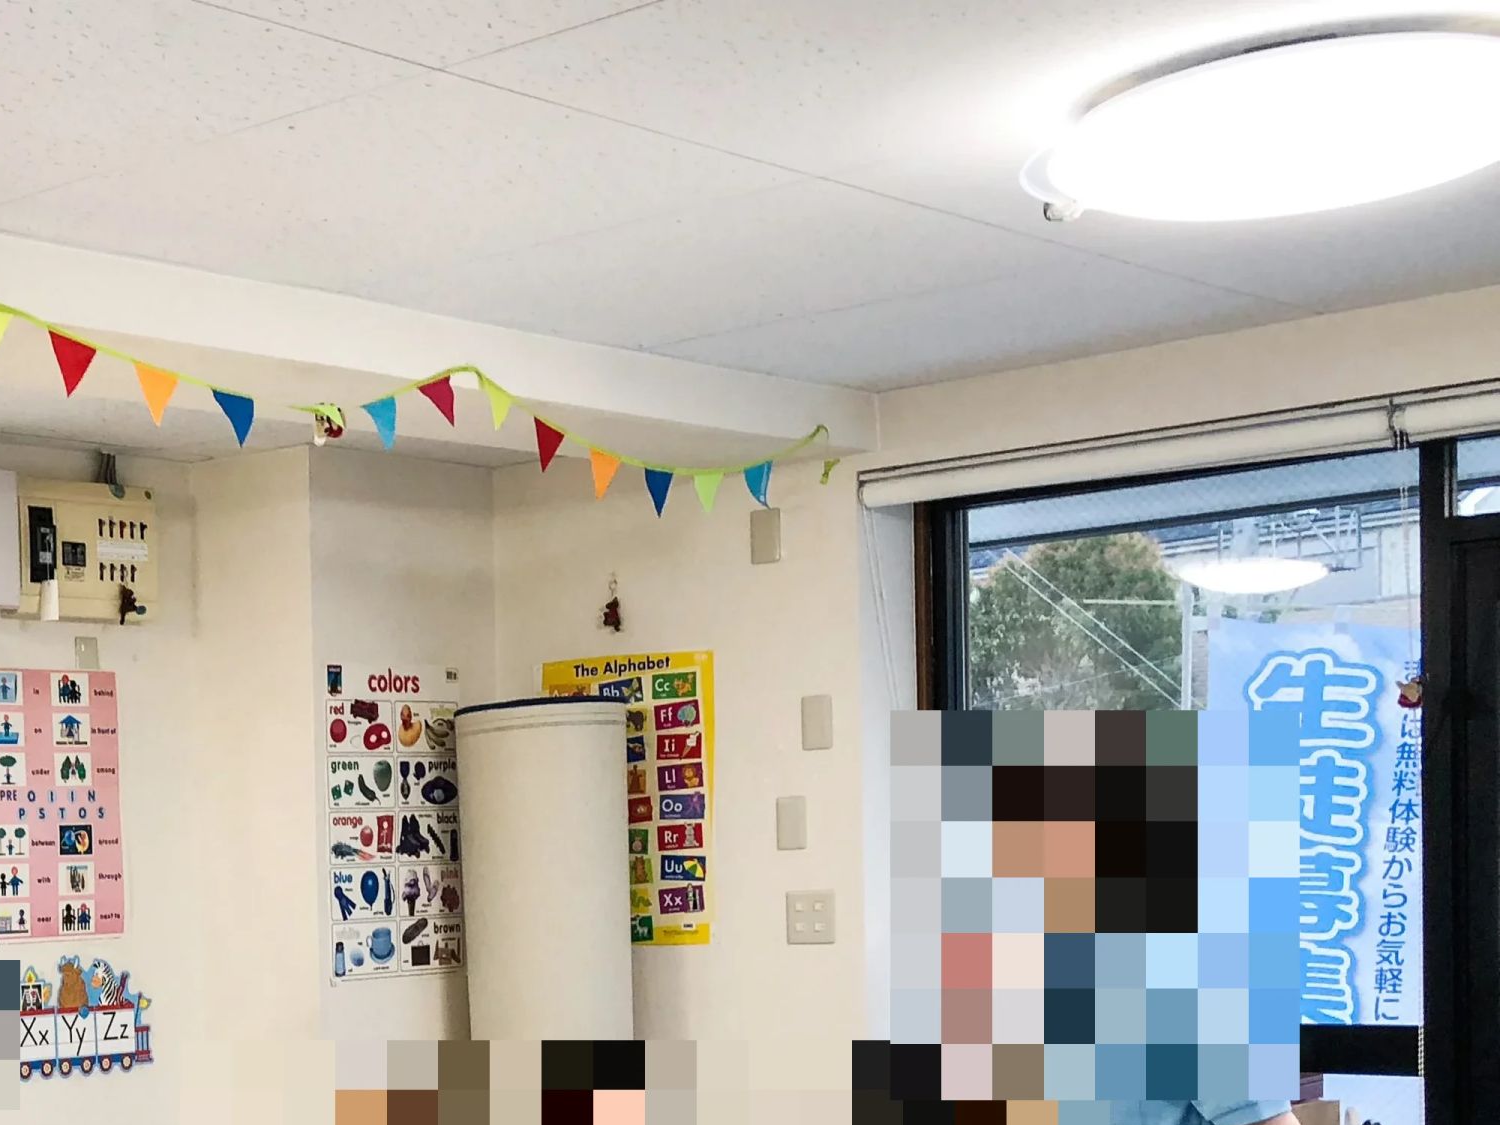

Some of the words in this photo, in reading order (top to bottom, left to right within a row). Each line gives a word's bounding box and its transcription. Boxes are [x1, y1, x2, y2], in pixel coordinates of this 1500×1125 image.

[574, 664, 598, 678] The
[603, 656, 670, 677] Alphabet
[368, 667, 420, 693] colors
[655, 679, 670, 692] Cc
[330, 702, 344, 715] red
[660, 707, 672, 723] Ff
[664, 739, 675, 752] Ii
[331, 760, 359, 774] green
[428, 758, 456, 773] purple
[665, 769, 676, 784] Ll
[0, 790, 17, 801] PRE
[662, 799, 682, 812] Oo
[333, 815, 363, 828] orange
[437, 813, 457, 824] black
[664, 830, 678, 844] Rr
[665, 859, 682, 873] Uu
[333, 871, 353, 884] blue
[663, 893, 682, 907] Xx
[433, 922, 461, 934] brown
[20, 1017, 49, 1047] Xx
[61, 1014, 86, 1056] Yy
[103, 1012, 129, 1040] Zz
